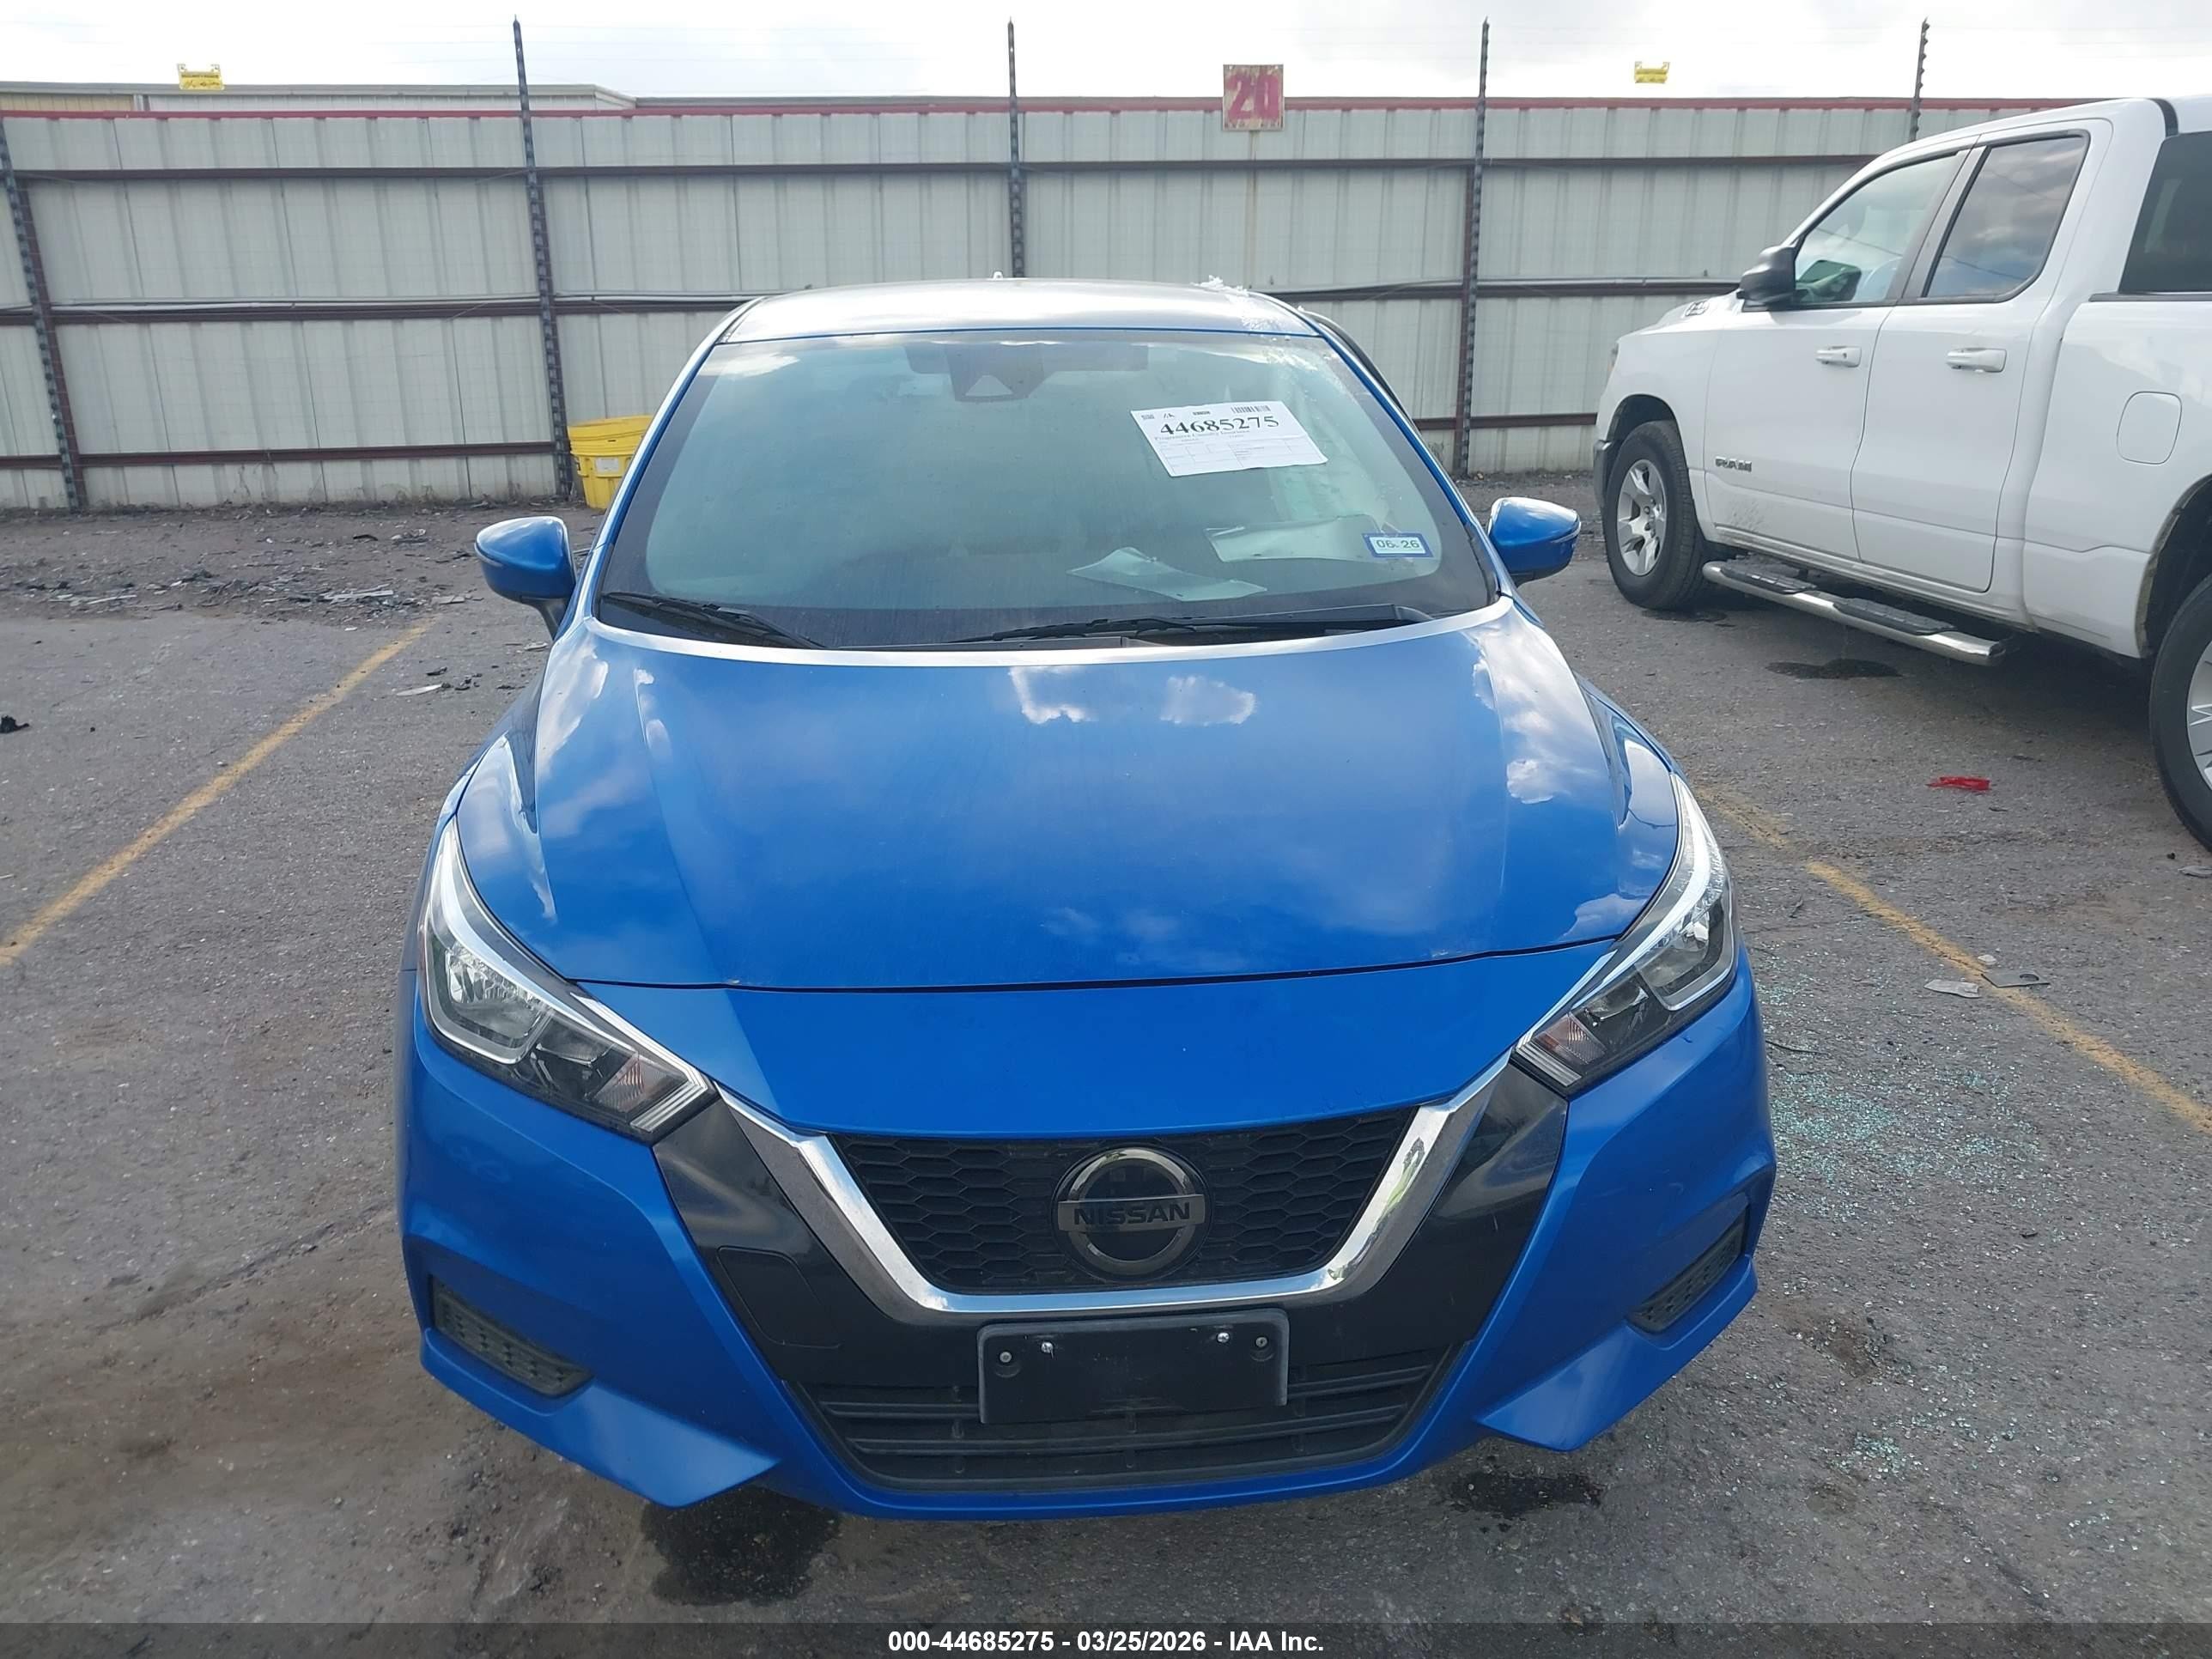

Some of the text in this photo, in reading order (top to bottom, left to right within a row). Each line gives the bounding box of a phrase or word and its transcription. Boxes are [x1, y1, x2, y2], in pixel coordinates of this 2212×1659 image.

[1160, 415, 1279, 435] 44685275
[1715, 456, 1753, 473] RAM
[1073, 1202, 1191, 1225] NISSAN
